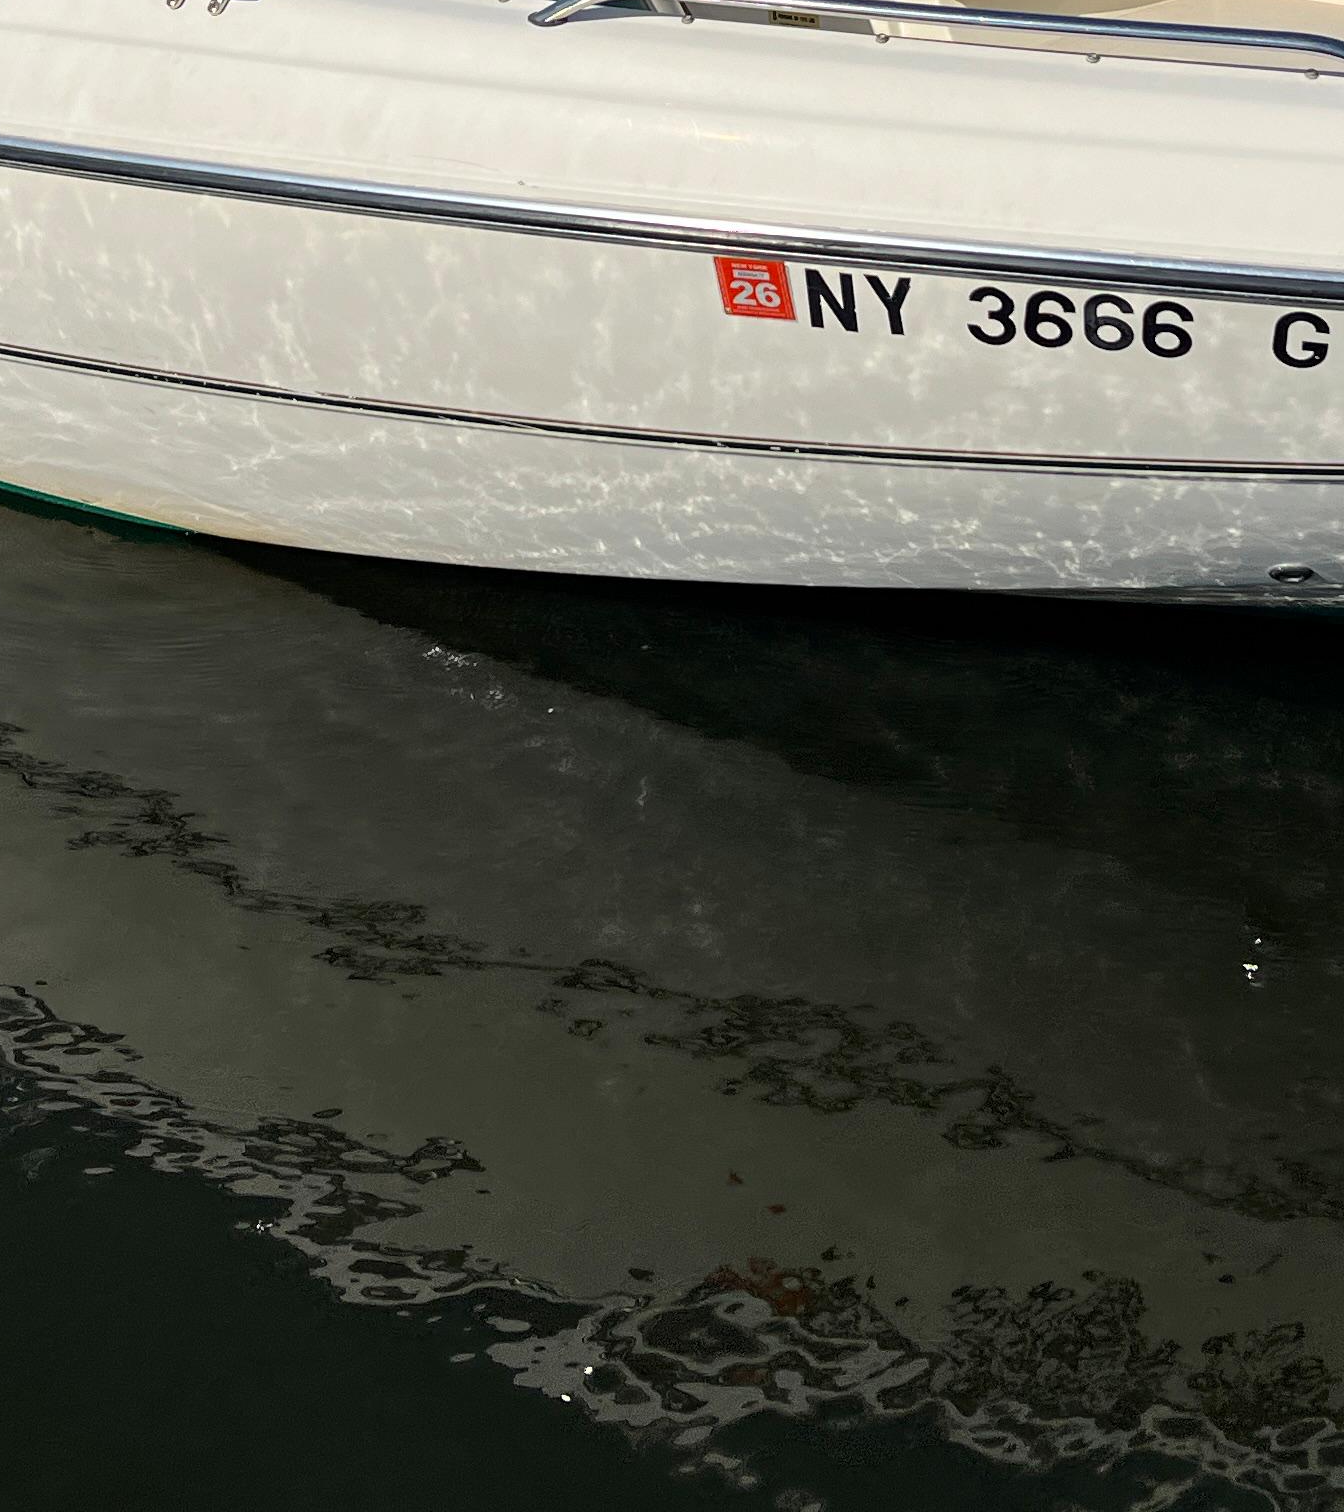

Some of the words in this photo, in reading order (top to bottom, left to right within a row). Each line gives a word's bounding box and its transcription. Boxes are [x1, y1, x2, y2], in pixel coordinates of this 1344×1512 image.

[730, 279, 782, 308] 26
[803, 268, 912, 336] NY
[967, 286, 1194, 359] 3666
